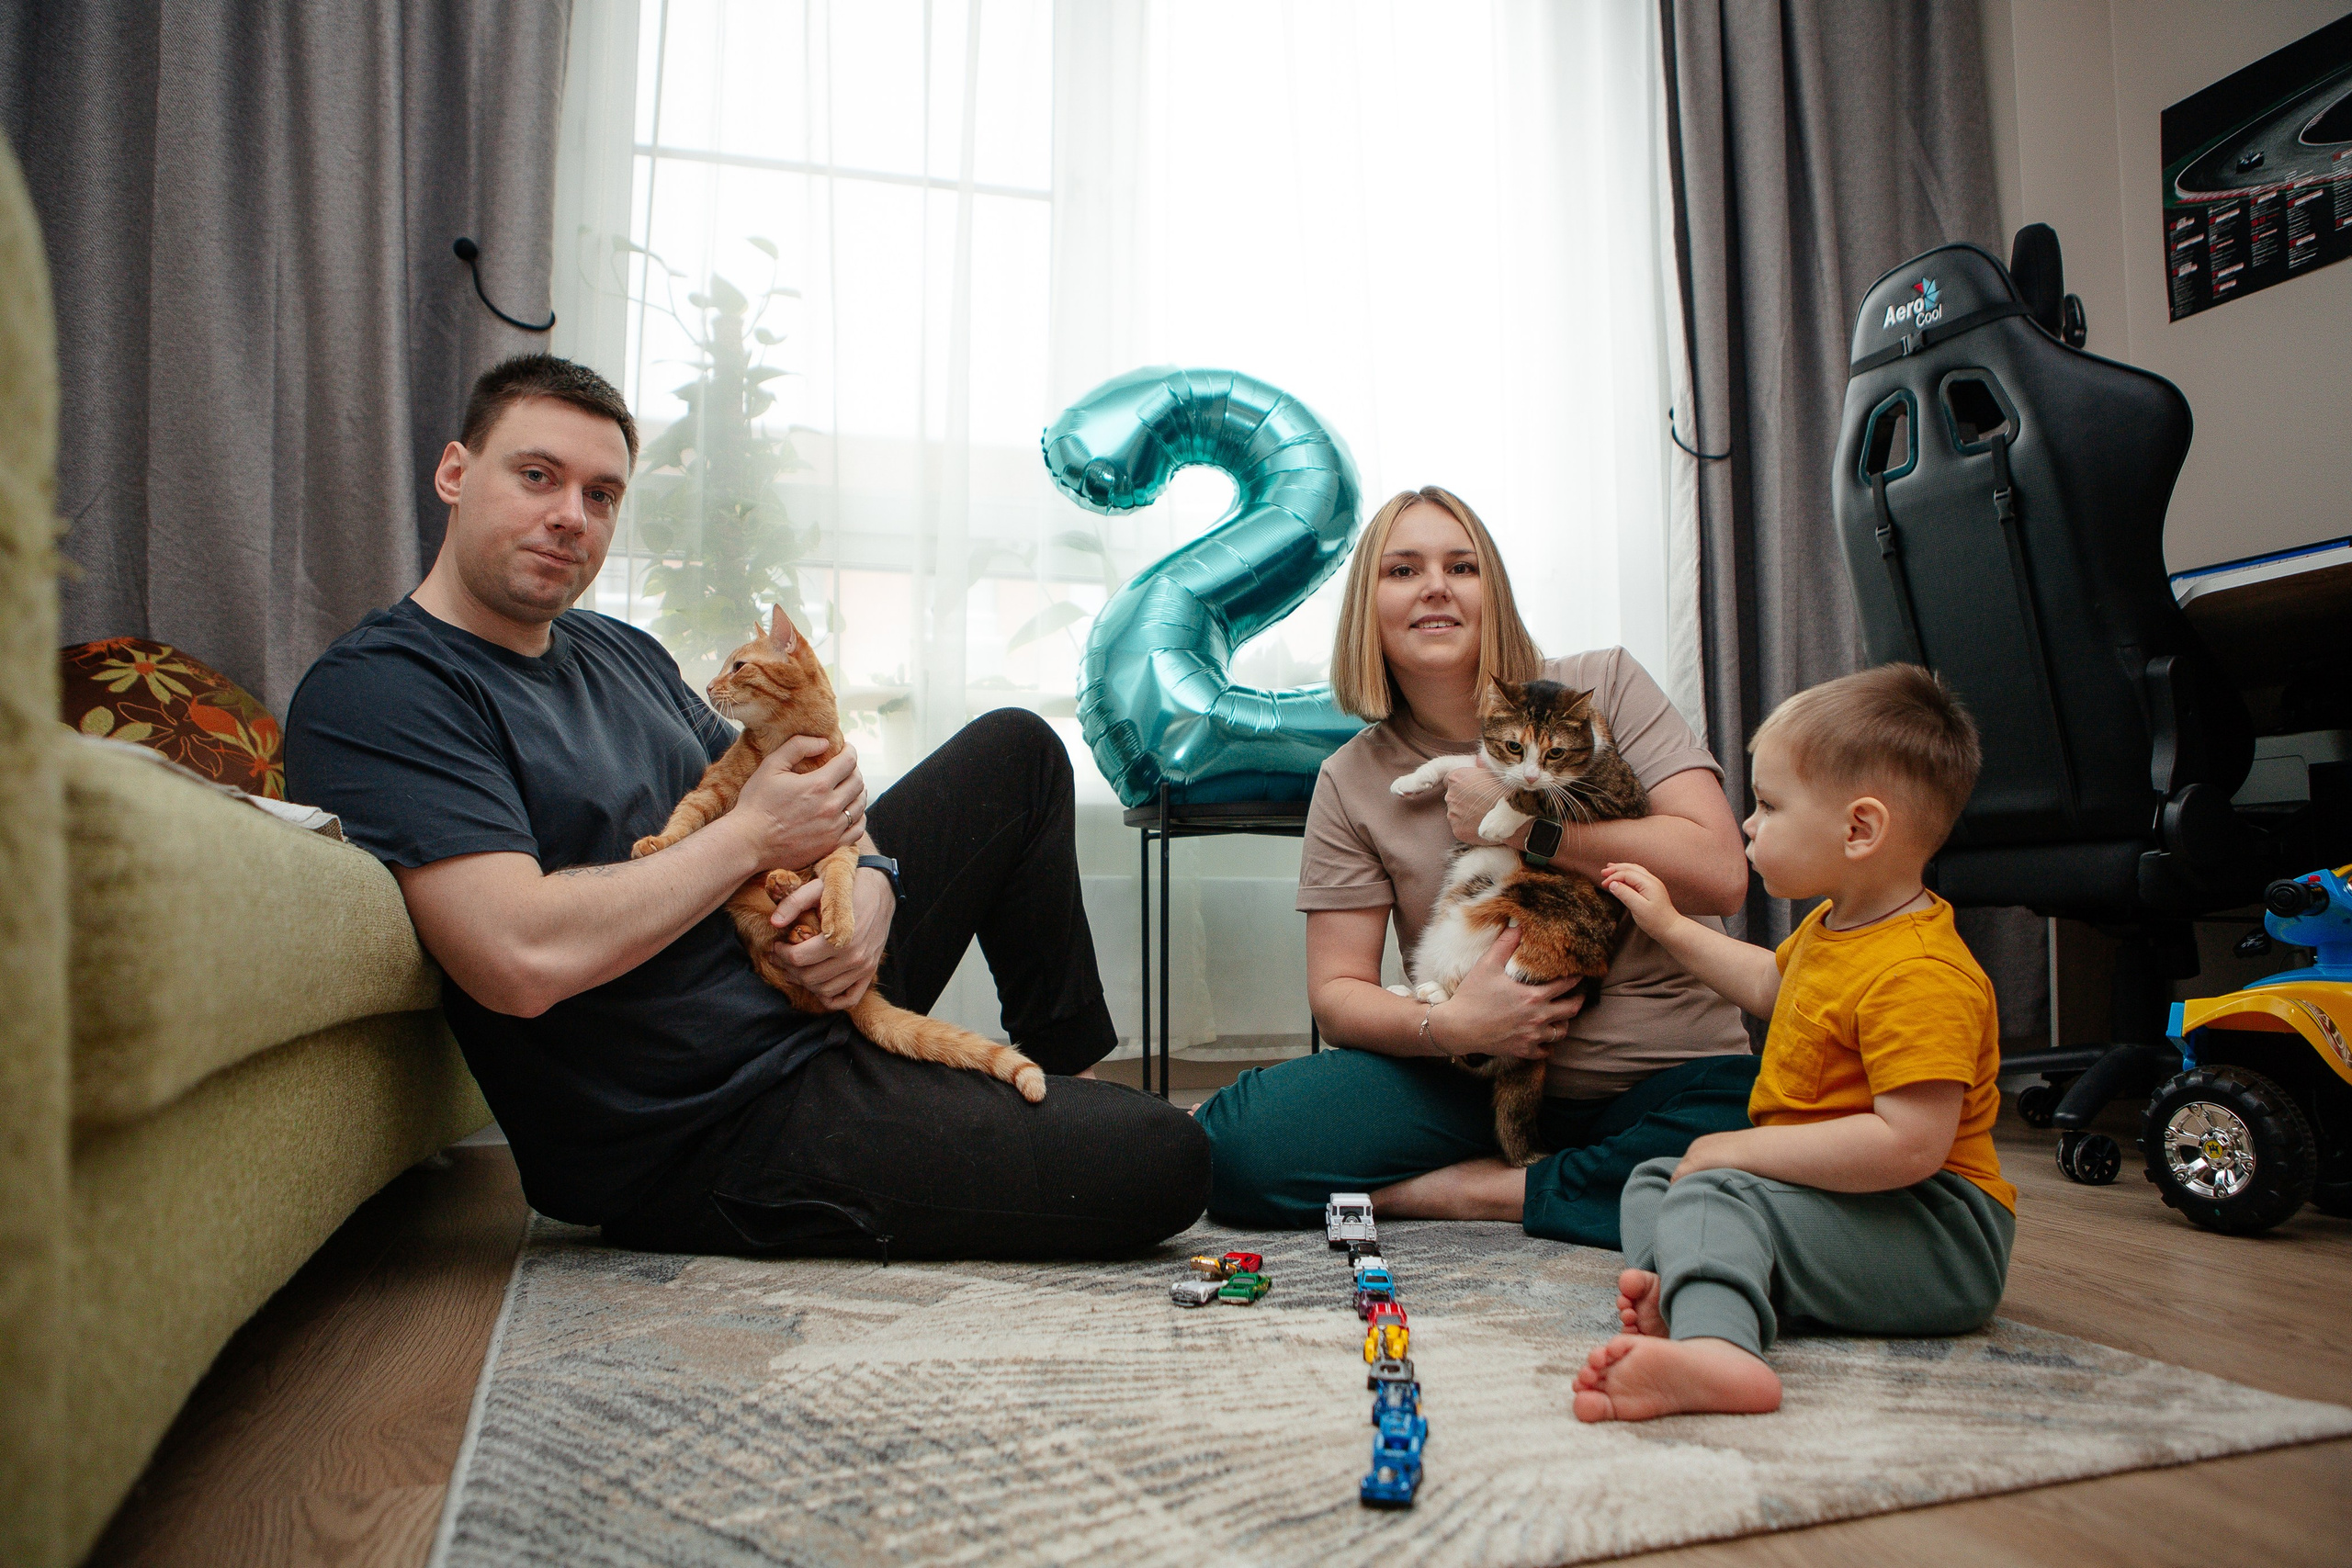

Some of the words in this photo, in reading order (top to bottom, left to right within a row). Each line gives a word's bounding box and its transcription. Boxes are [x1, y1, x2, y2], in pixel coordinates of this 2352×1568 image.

[1883, 298, 1925, 329] Aero
[1916, 303, 1942, 329] Cool
[1042, 366, 1363, 808] 2
